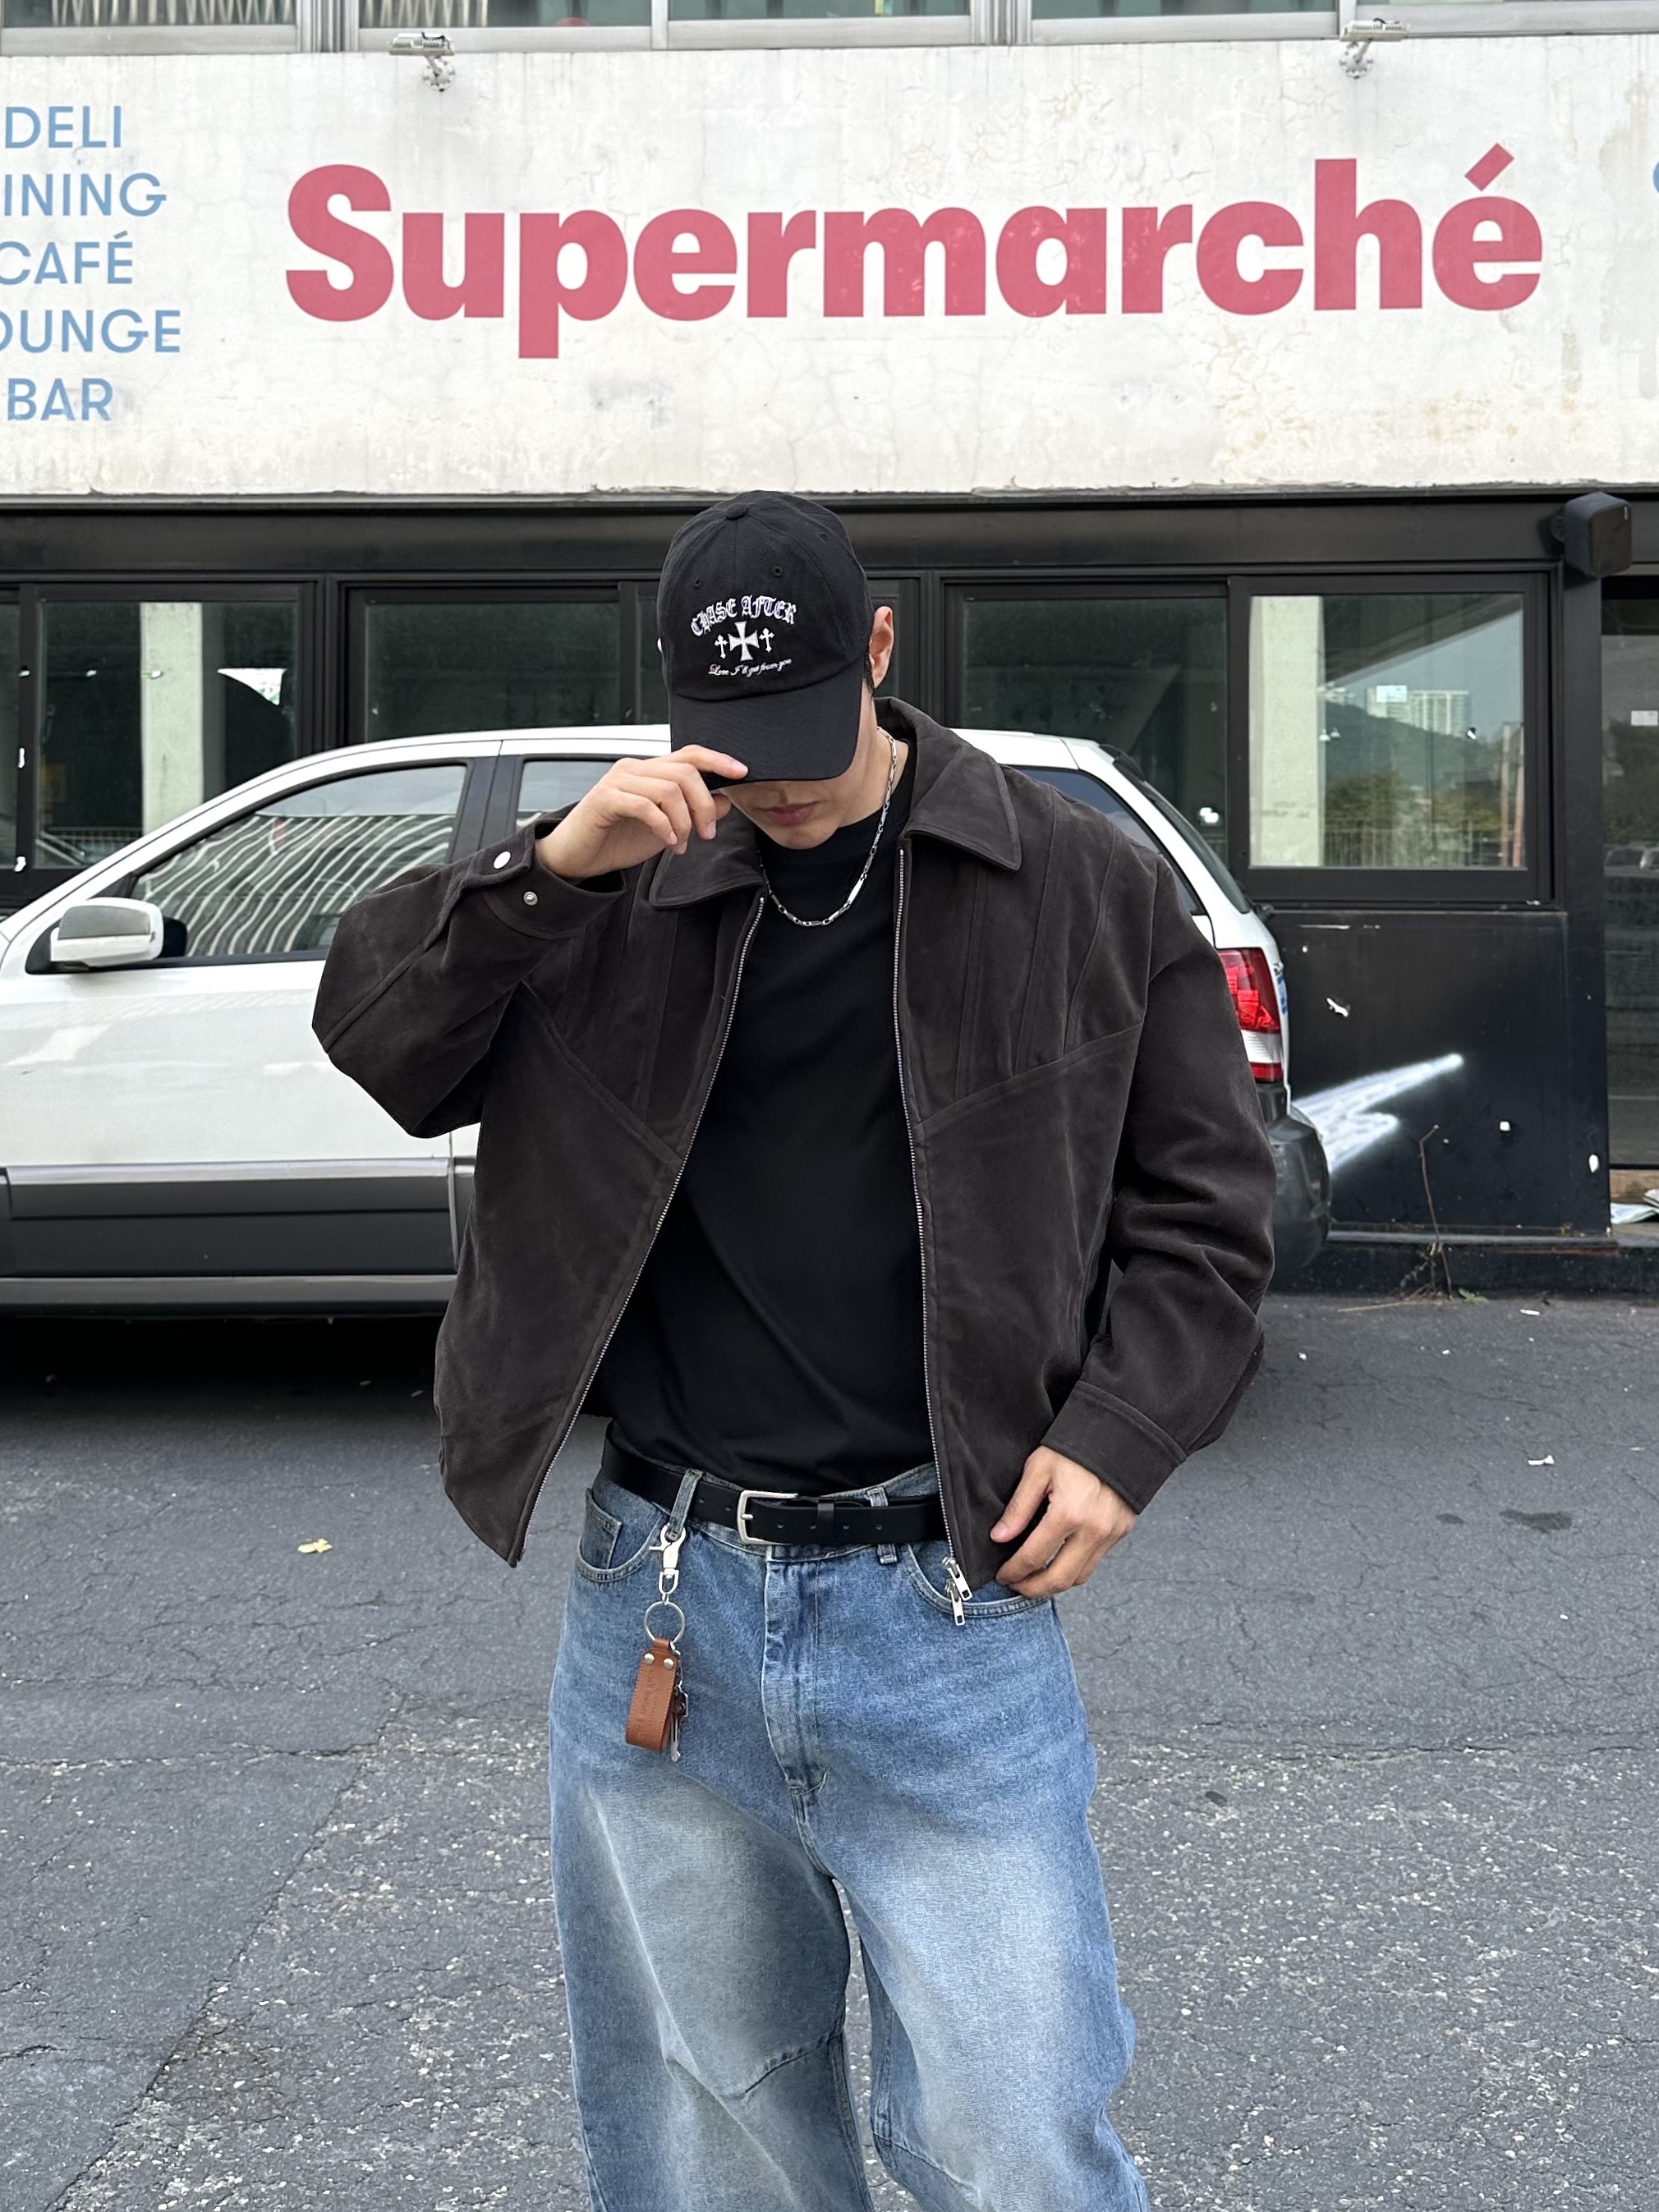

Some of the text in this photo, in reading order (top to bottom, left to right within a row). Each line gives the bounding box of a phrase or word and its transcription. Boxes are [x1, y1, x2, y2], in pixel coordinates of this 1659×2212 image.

[5, 105, 122, 149] DELI
[0, 230, 133, 285] CAFÉ
[285, 145, 1542, 359] Supermarché
[7, 378, 113, 421] BAR
[691, 594, 797, 636] CHASE AFTER
